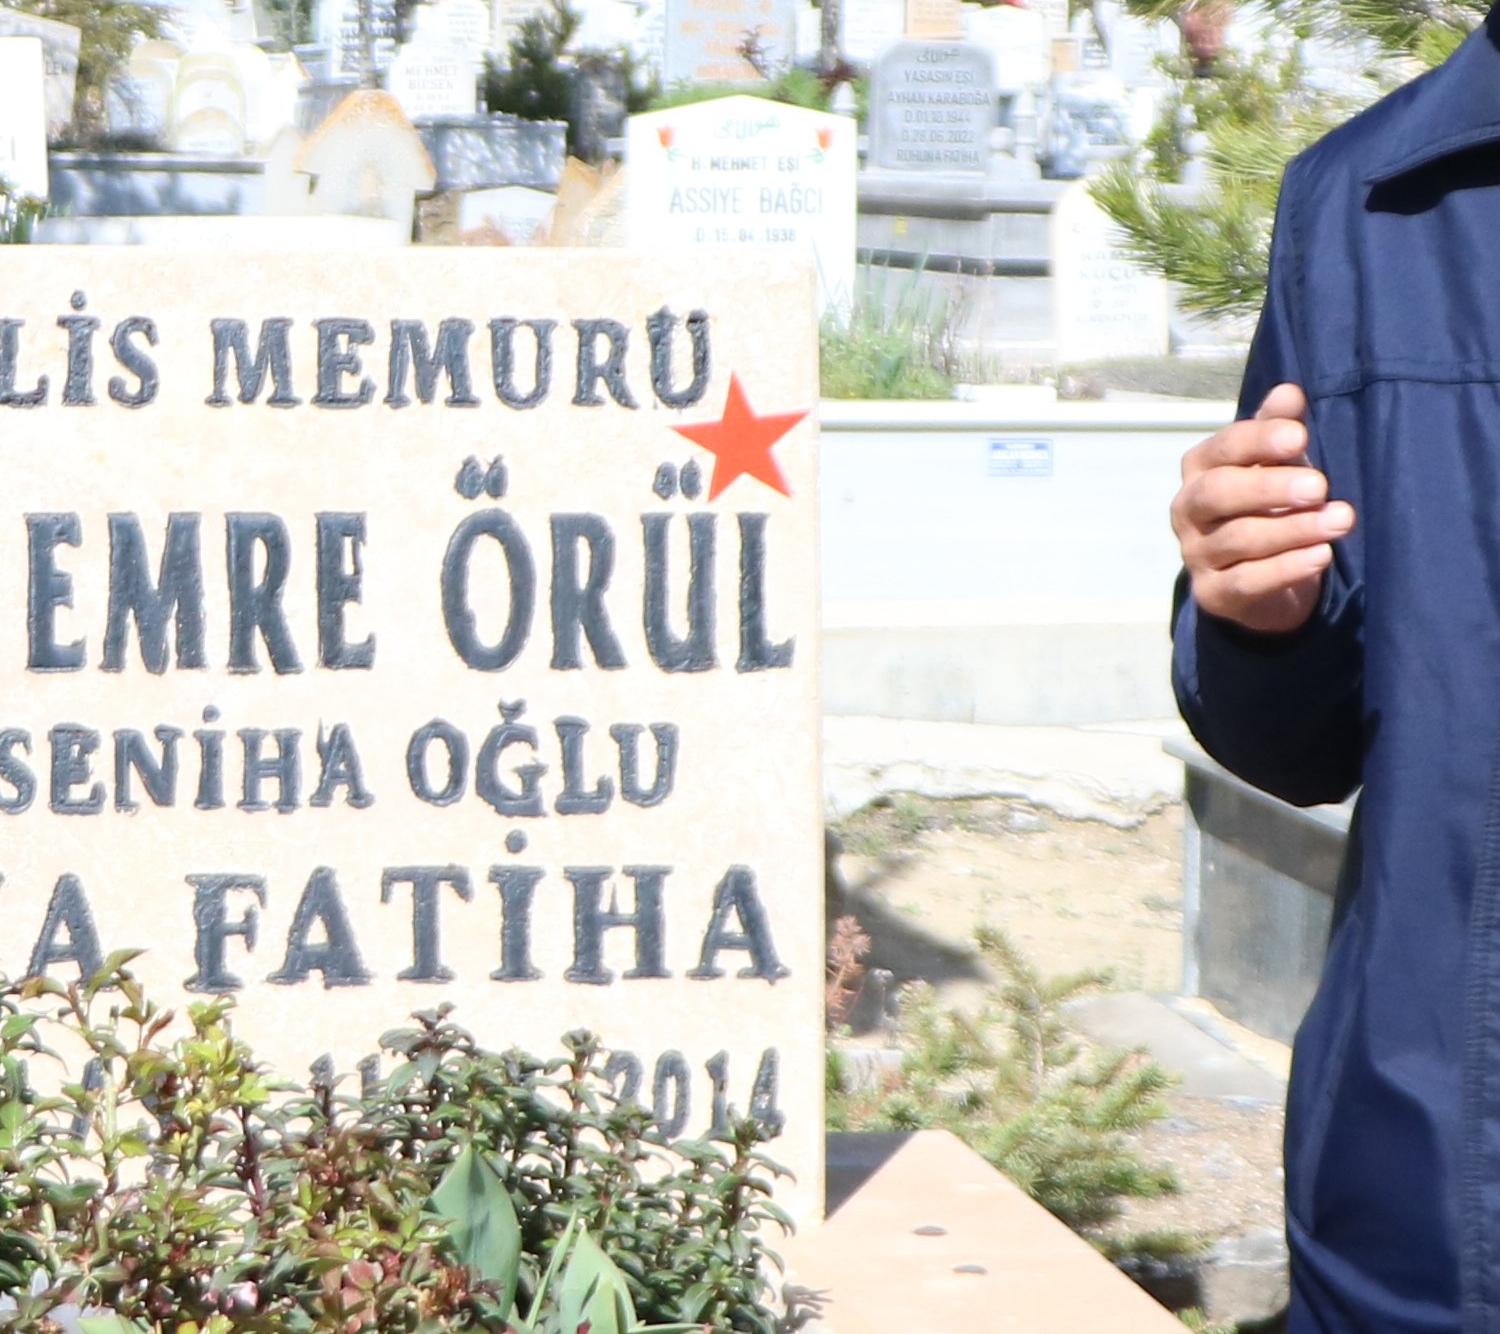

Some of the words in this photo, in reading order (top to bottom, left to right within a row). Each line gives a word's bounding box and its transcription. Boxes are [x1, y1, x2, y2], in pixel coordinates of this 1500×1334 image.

[23, 510, 377, 676] EMRE
[439, 453, 797, 674] ÖRÜL
[404, 698, 682, 817] OĞLU
[183, 828, 794, 996] FATİHA
